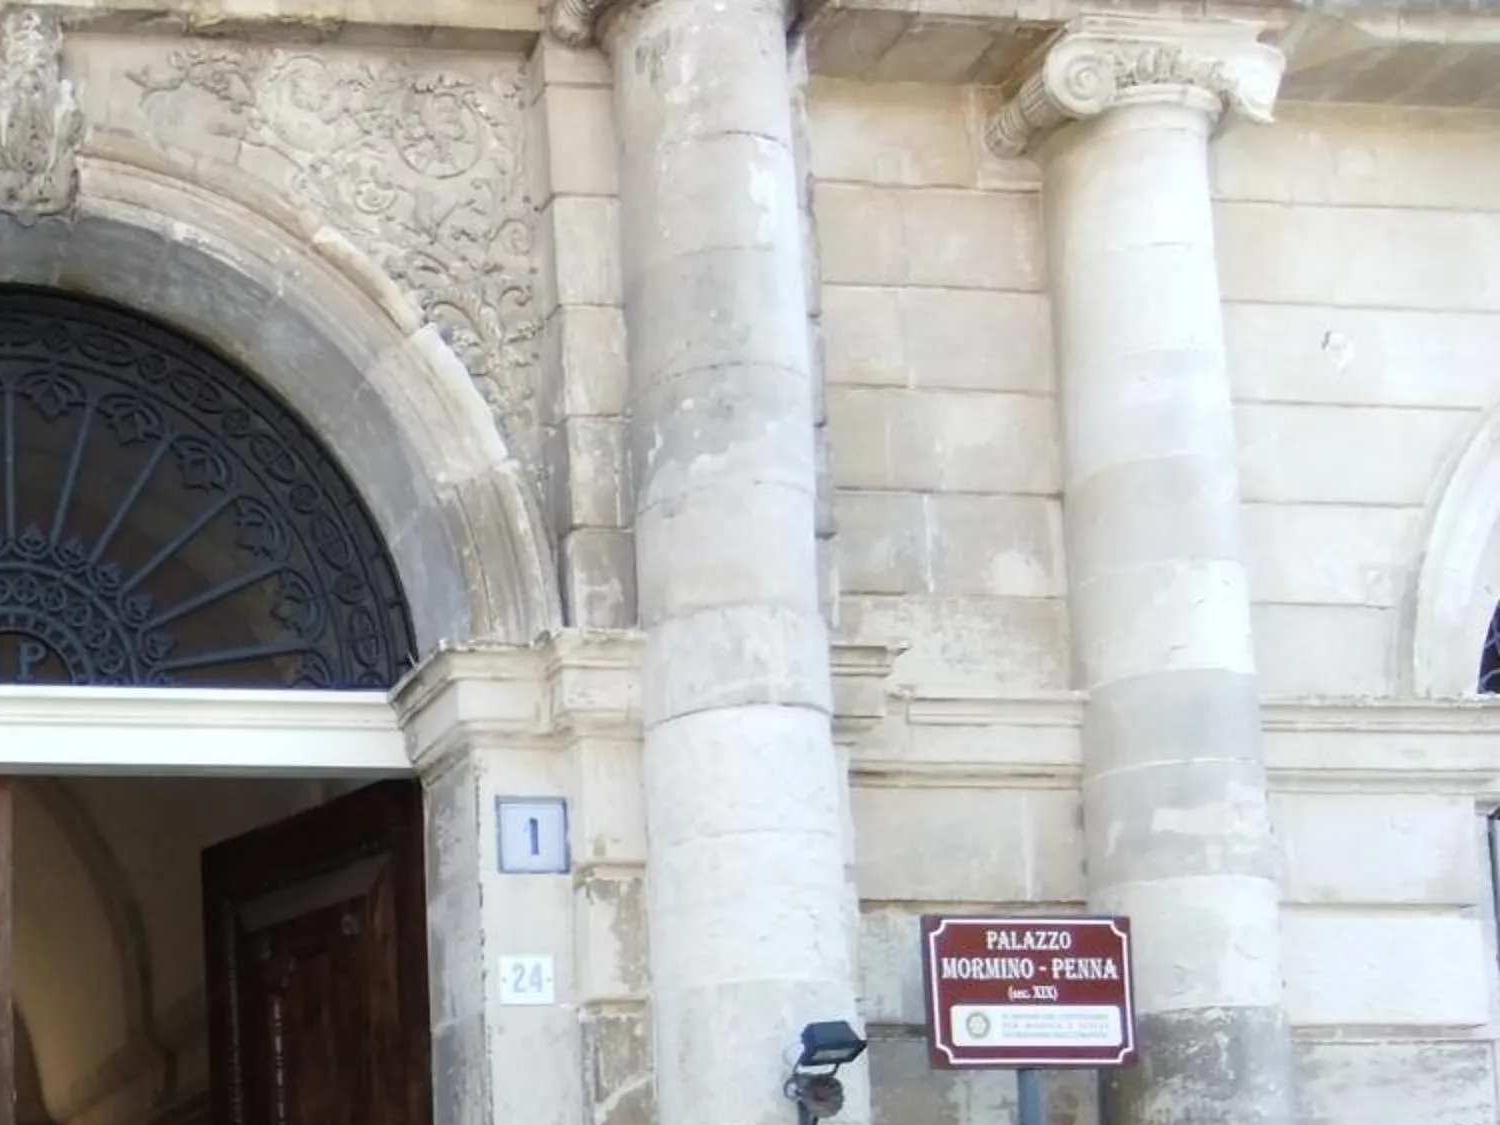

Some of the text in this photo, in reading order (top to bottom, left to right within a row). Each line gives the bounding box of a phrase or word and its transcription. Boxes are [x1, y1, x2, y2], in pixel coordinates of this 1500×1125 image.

[524, 817, 540, 855] 1
[986, 930, 1071, 950] PALAZZO
[511, 962, 543, 994] 24
[941, 957, 1034, 980] MORMINO
[1052, 958, 1119, 980] PENNA
[1032, 985, 1058, 1001] XIX)
